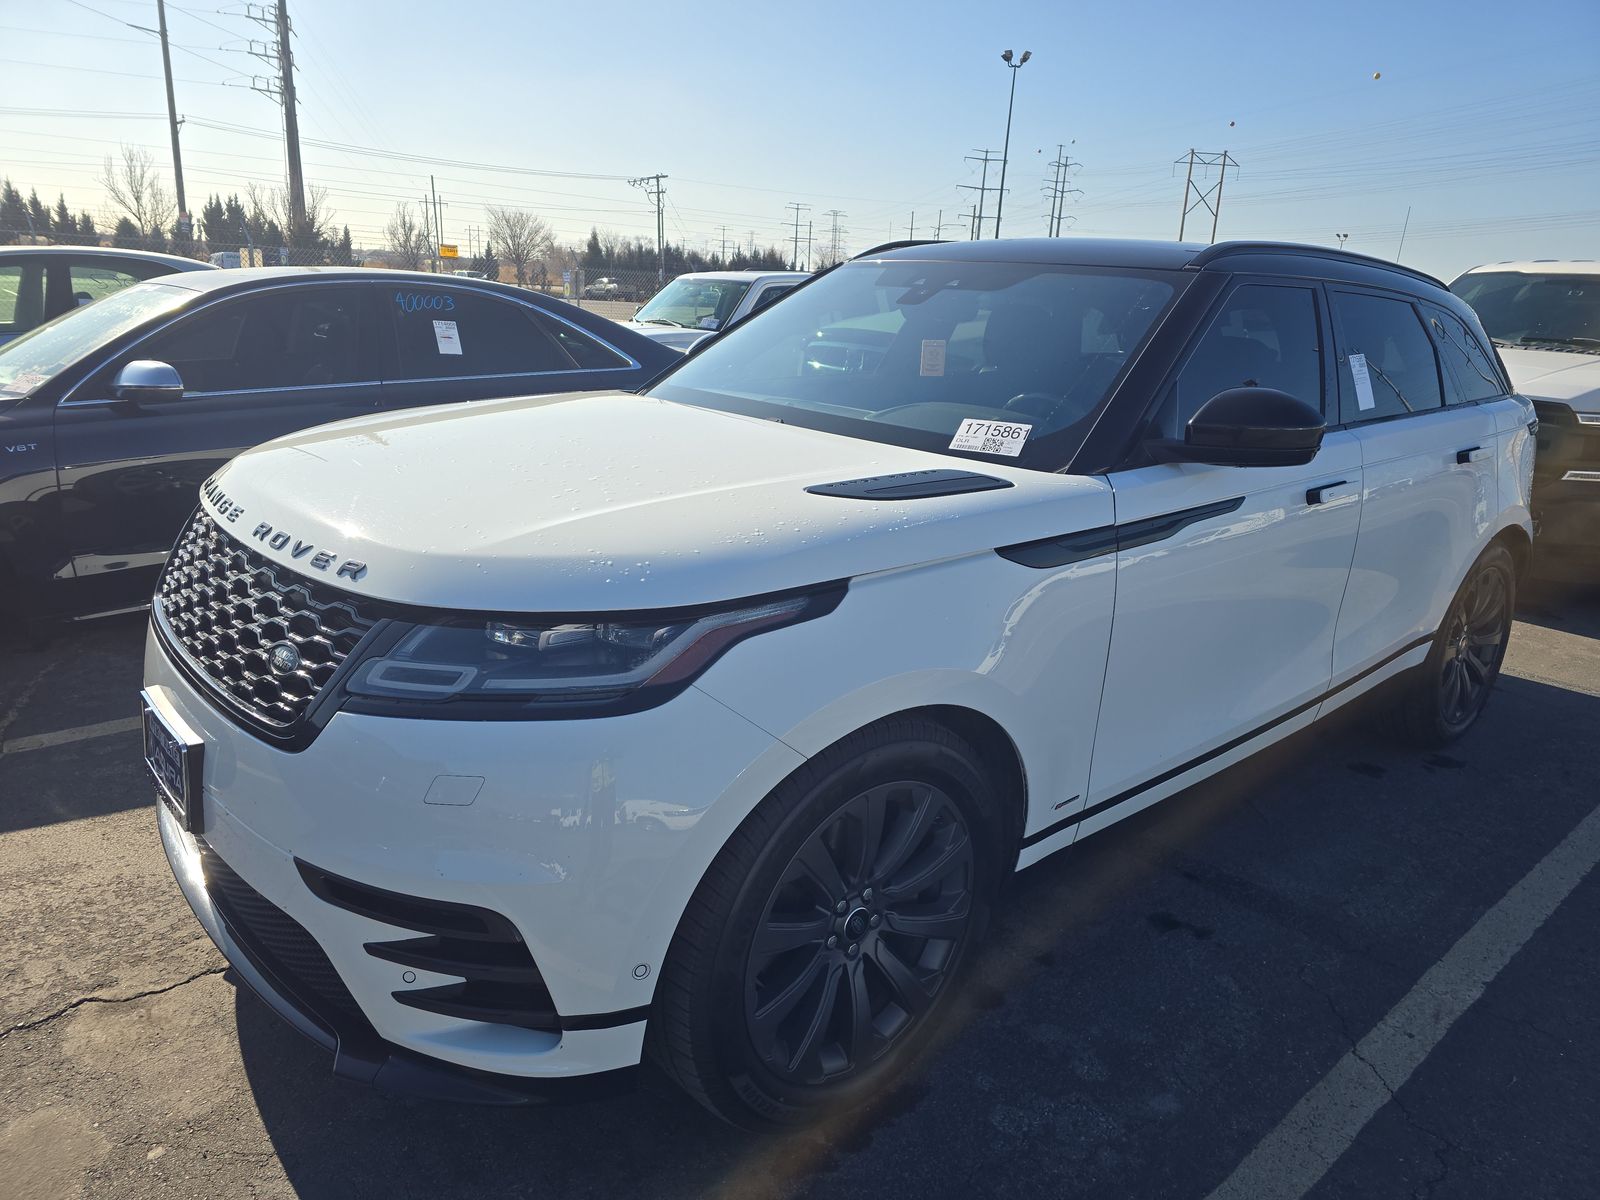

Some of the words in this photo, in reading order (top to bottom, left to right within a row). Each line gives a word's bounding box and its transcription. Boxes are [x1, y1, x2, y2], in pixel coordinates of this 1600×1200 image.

[966, 422, 1031, 441] 1715861
[204, 475, 244, 523] RANGE
[252, 521, 368, 582] ROVER
